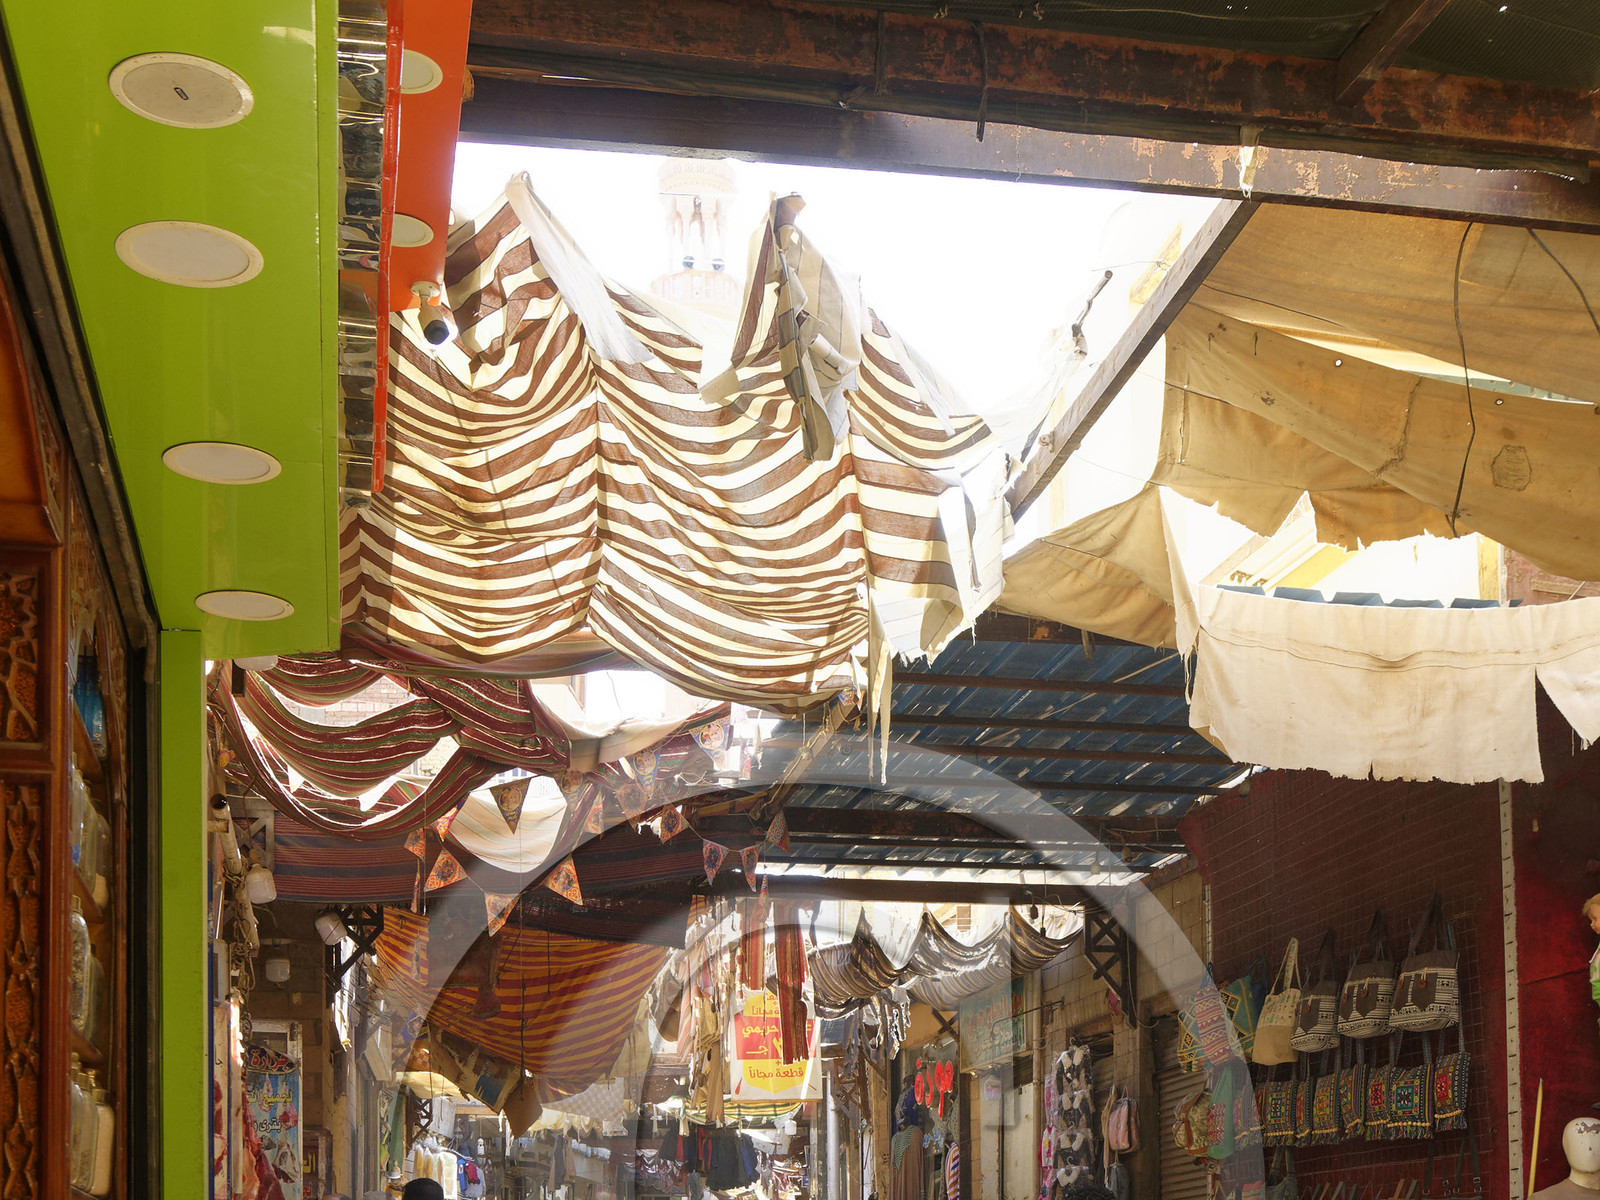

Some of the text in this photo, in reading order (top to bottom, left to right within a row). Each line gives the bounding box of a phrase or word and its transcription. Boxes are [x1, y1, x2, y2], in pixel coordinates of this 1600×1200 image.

[742, 1024, 779, 1038] حريمي
[748, 1066, 804, 1079] قطعة مجاناً
[263, 1090, 293, 1107] لجميع
